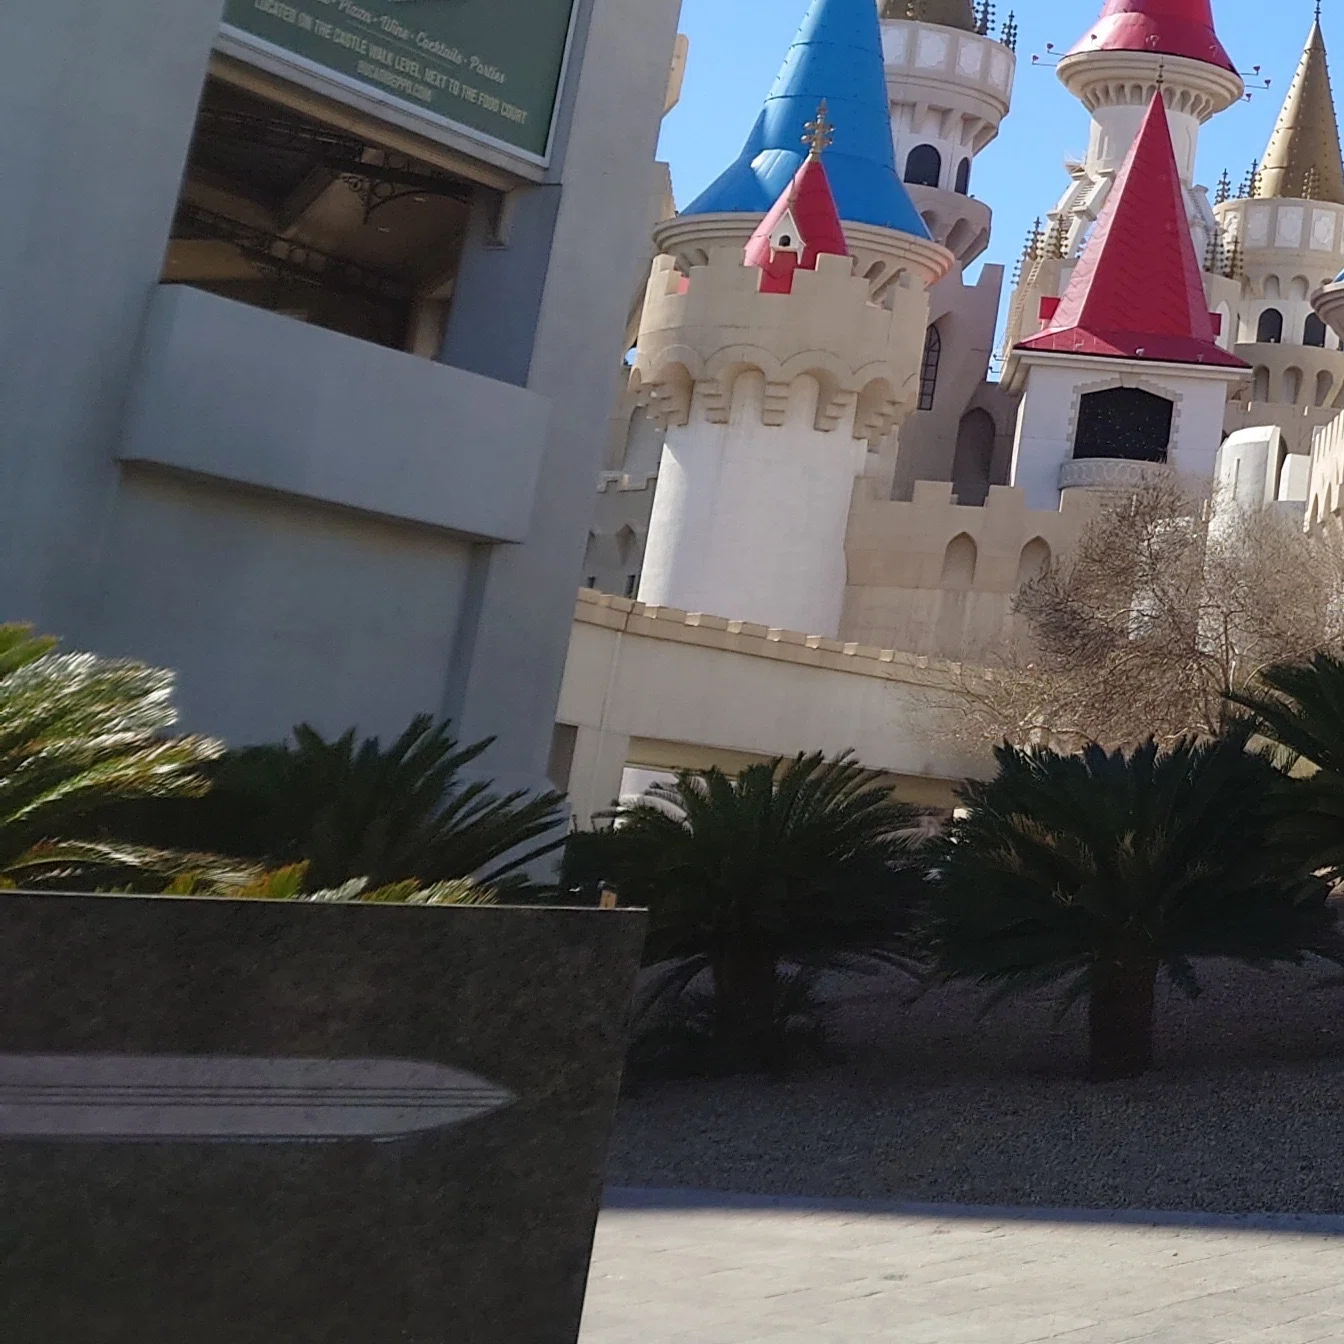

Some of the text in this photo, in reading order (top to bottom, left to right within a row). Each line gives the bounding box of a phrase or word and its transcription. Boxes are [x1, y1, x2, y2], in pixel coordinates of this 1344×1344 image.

[314, 19, 333, 39] THE
[333, 28, 368, 54] CASTLE
[424, 68, 448, 89] NEXT
[448, 78, 460, 96] TO
[460, 85, 478, 104] THE
[478, 93, 500, 113] FOOD
[500, 102, 527, 124] COURT
[415, 31, 462, 65] Cocktails
[469, 56, 506, 84] Parties
